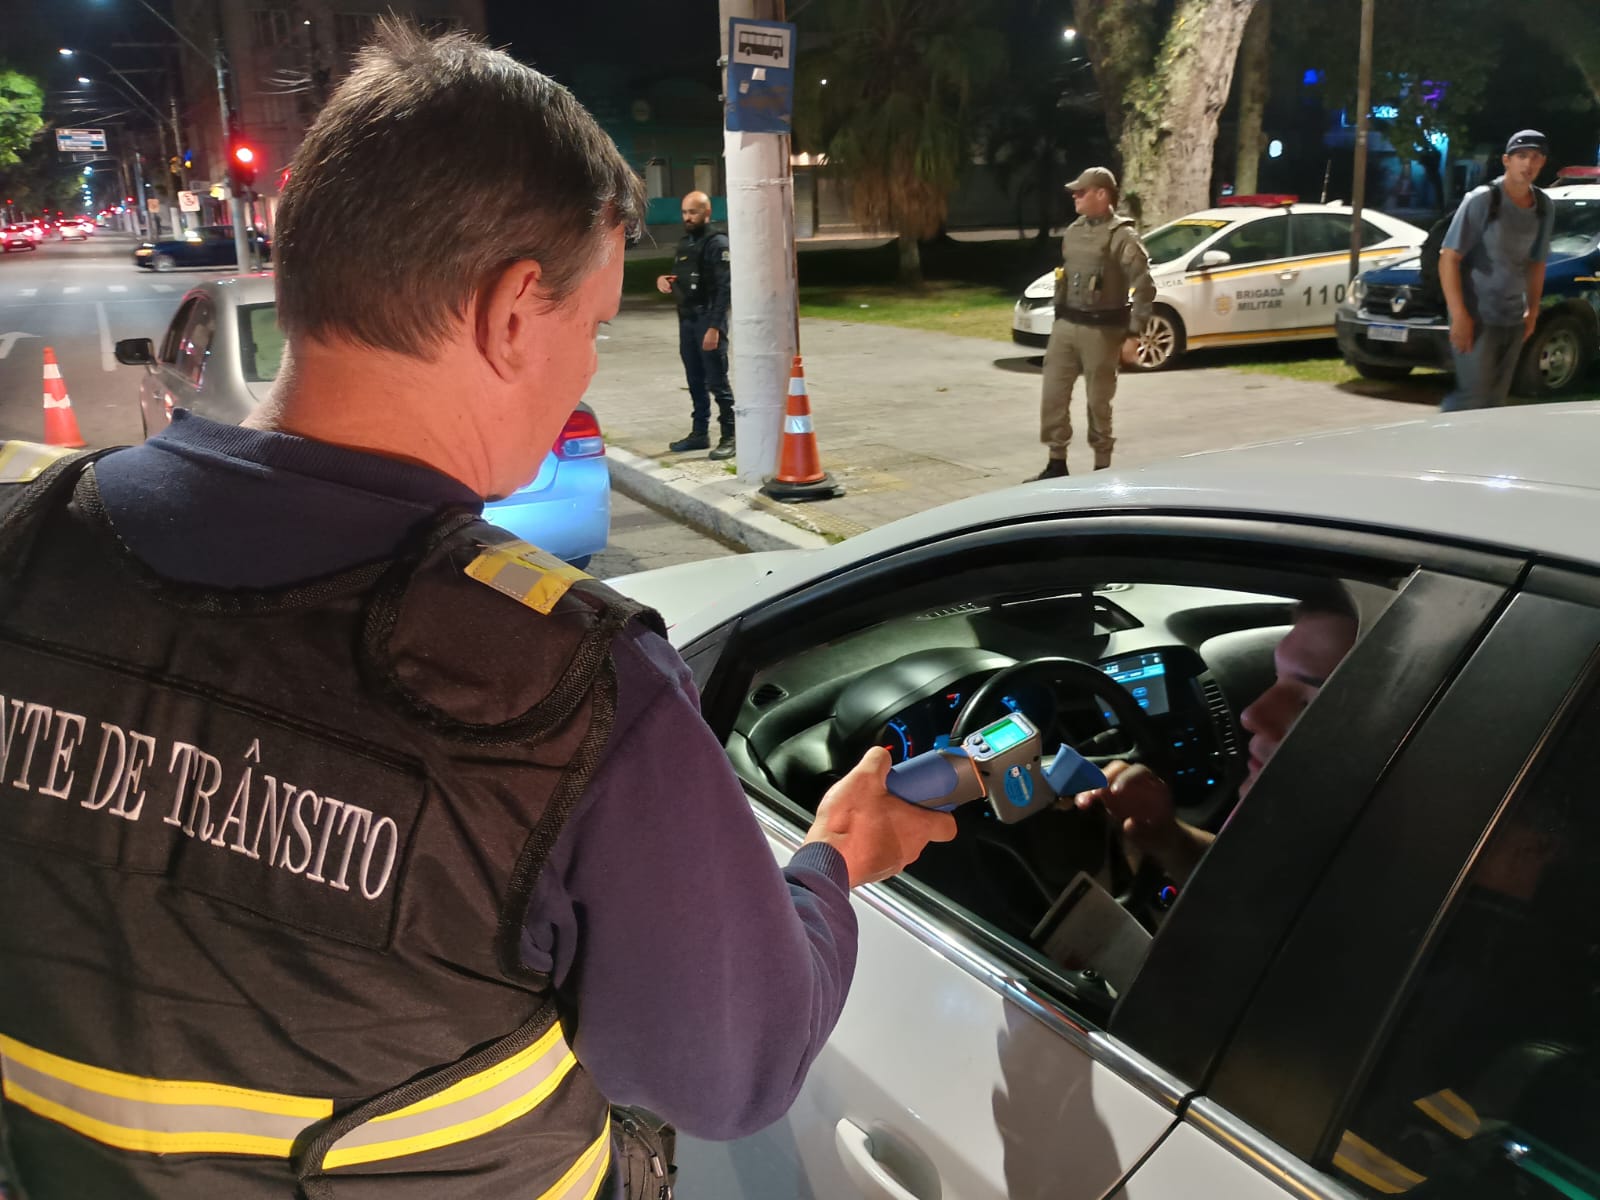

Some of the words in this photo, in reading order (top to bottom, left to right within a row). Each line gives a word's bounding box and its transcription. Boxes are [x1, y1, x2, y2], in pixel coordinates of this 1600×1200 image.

[1236, 288, 1285, 300] BRIGADA
[1303, 284, 1346, 306] 110
[1237, 299, 1282, 312] MILITAR
[80, 721, 156, 821] DE
[163, 738, 398, 900] TRÂNSITO
